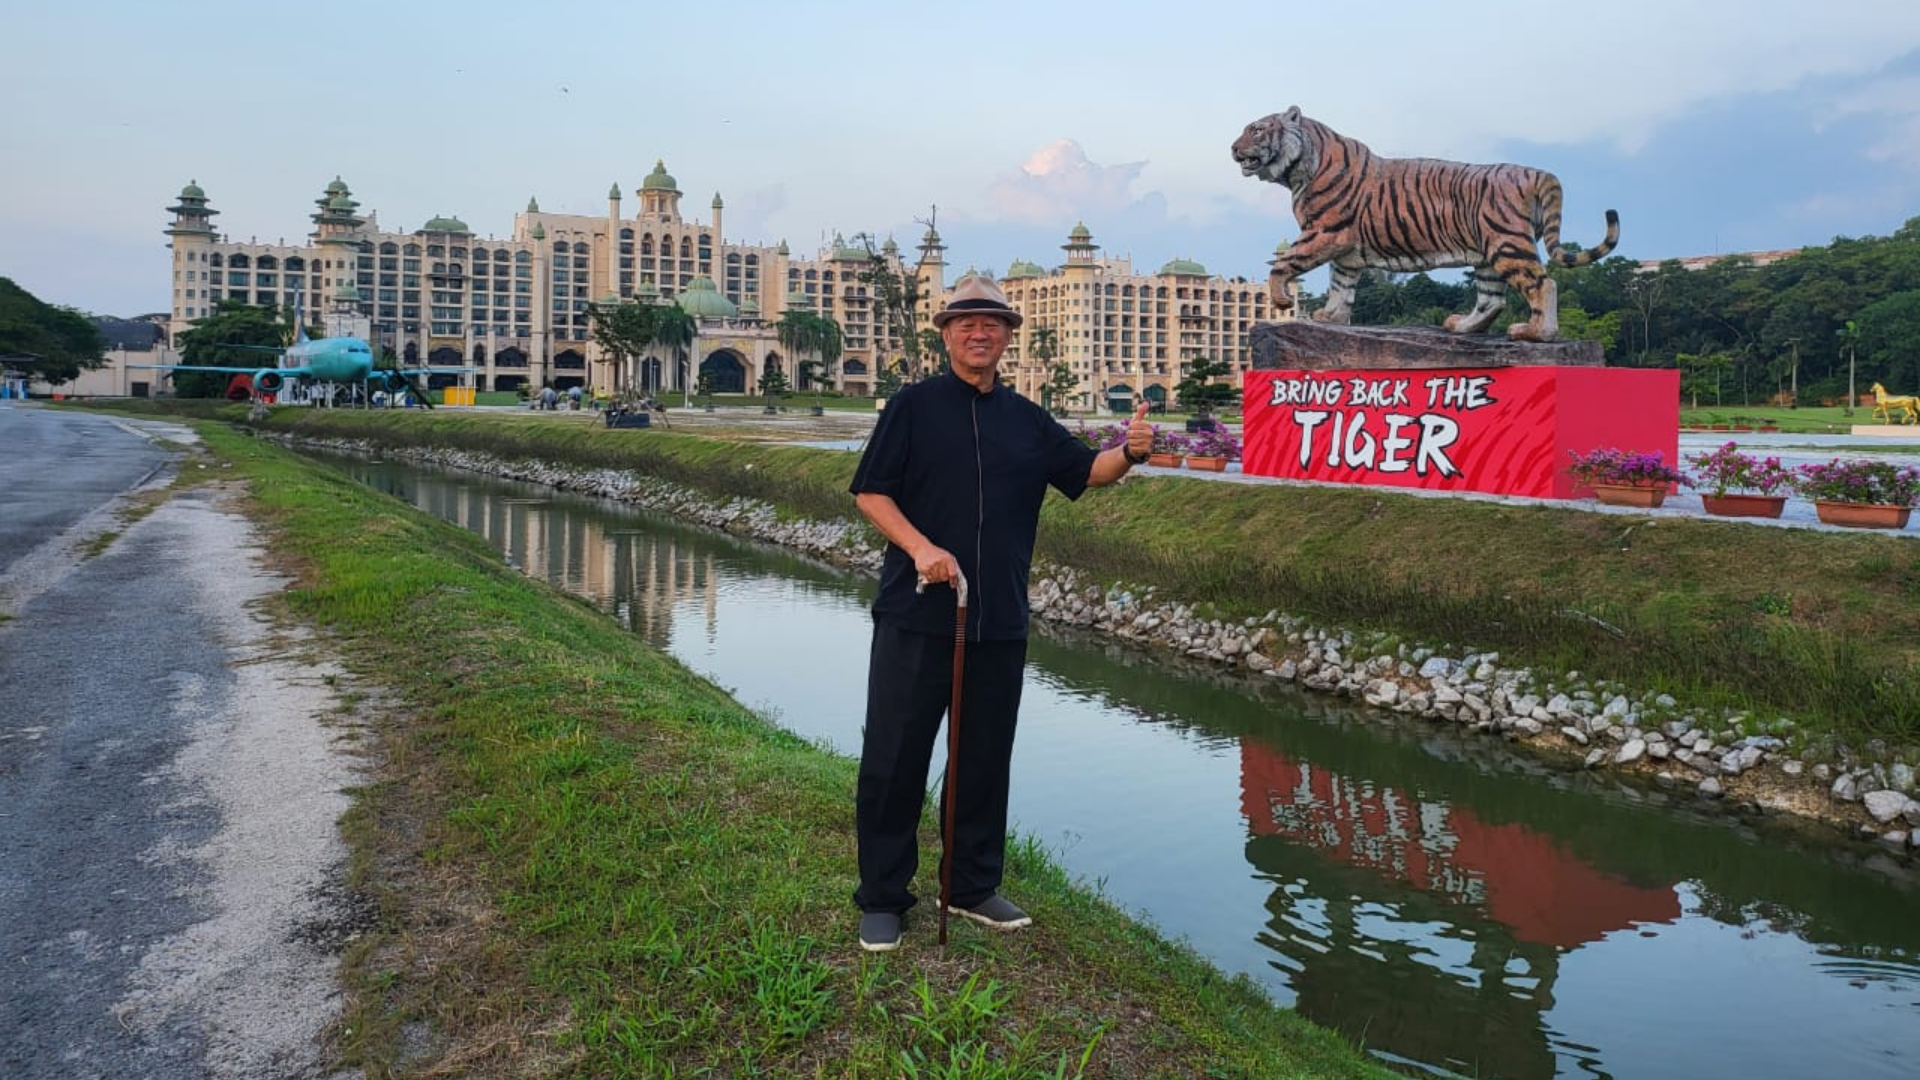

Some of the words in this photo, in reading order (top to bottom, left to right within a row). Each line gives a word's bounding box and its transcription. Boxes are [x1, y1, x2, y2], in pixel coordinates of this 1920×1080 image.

[1347, 377, 1409, 409] BACK
[1425, 376, 1494, 408] THE
[1294, 410, 1461, 477] TIGER
